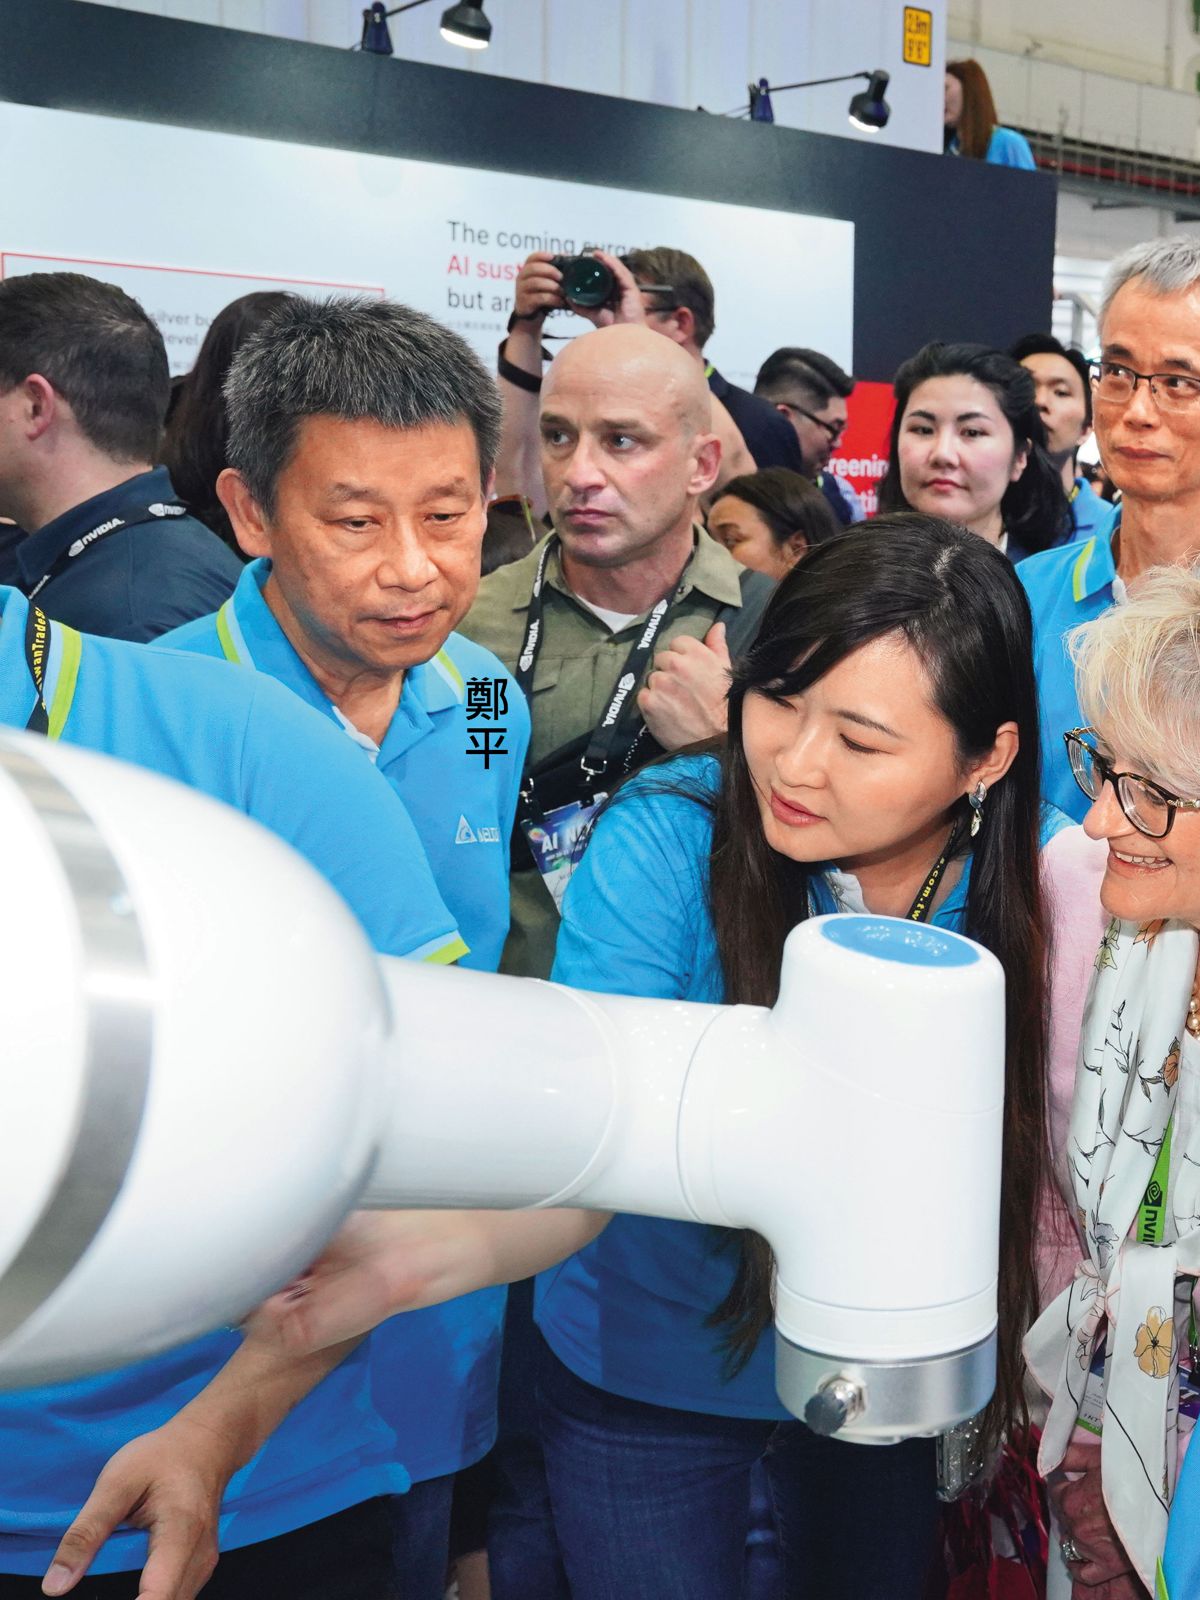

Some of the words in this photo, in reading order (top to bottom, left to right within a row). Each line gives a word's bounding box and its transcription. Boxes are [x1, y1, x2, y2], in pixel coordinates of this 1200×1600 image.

[448, 221, 489, 245] The
[496, 230, 575, 256] coming
[447, 288, 483, 310] but
